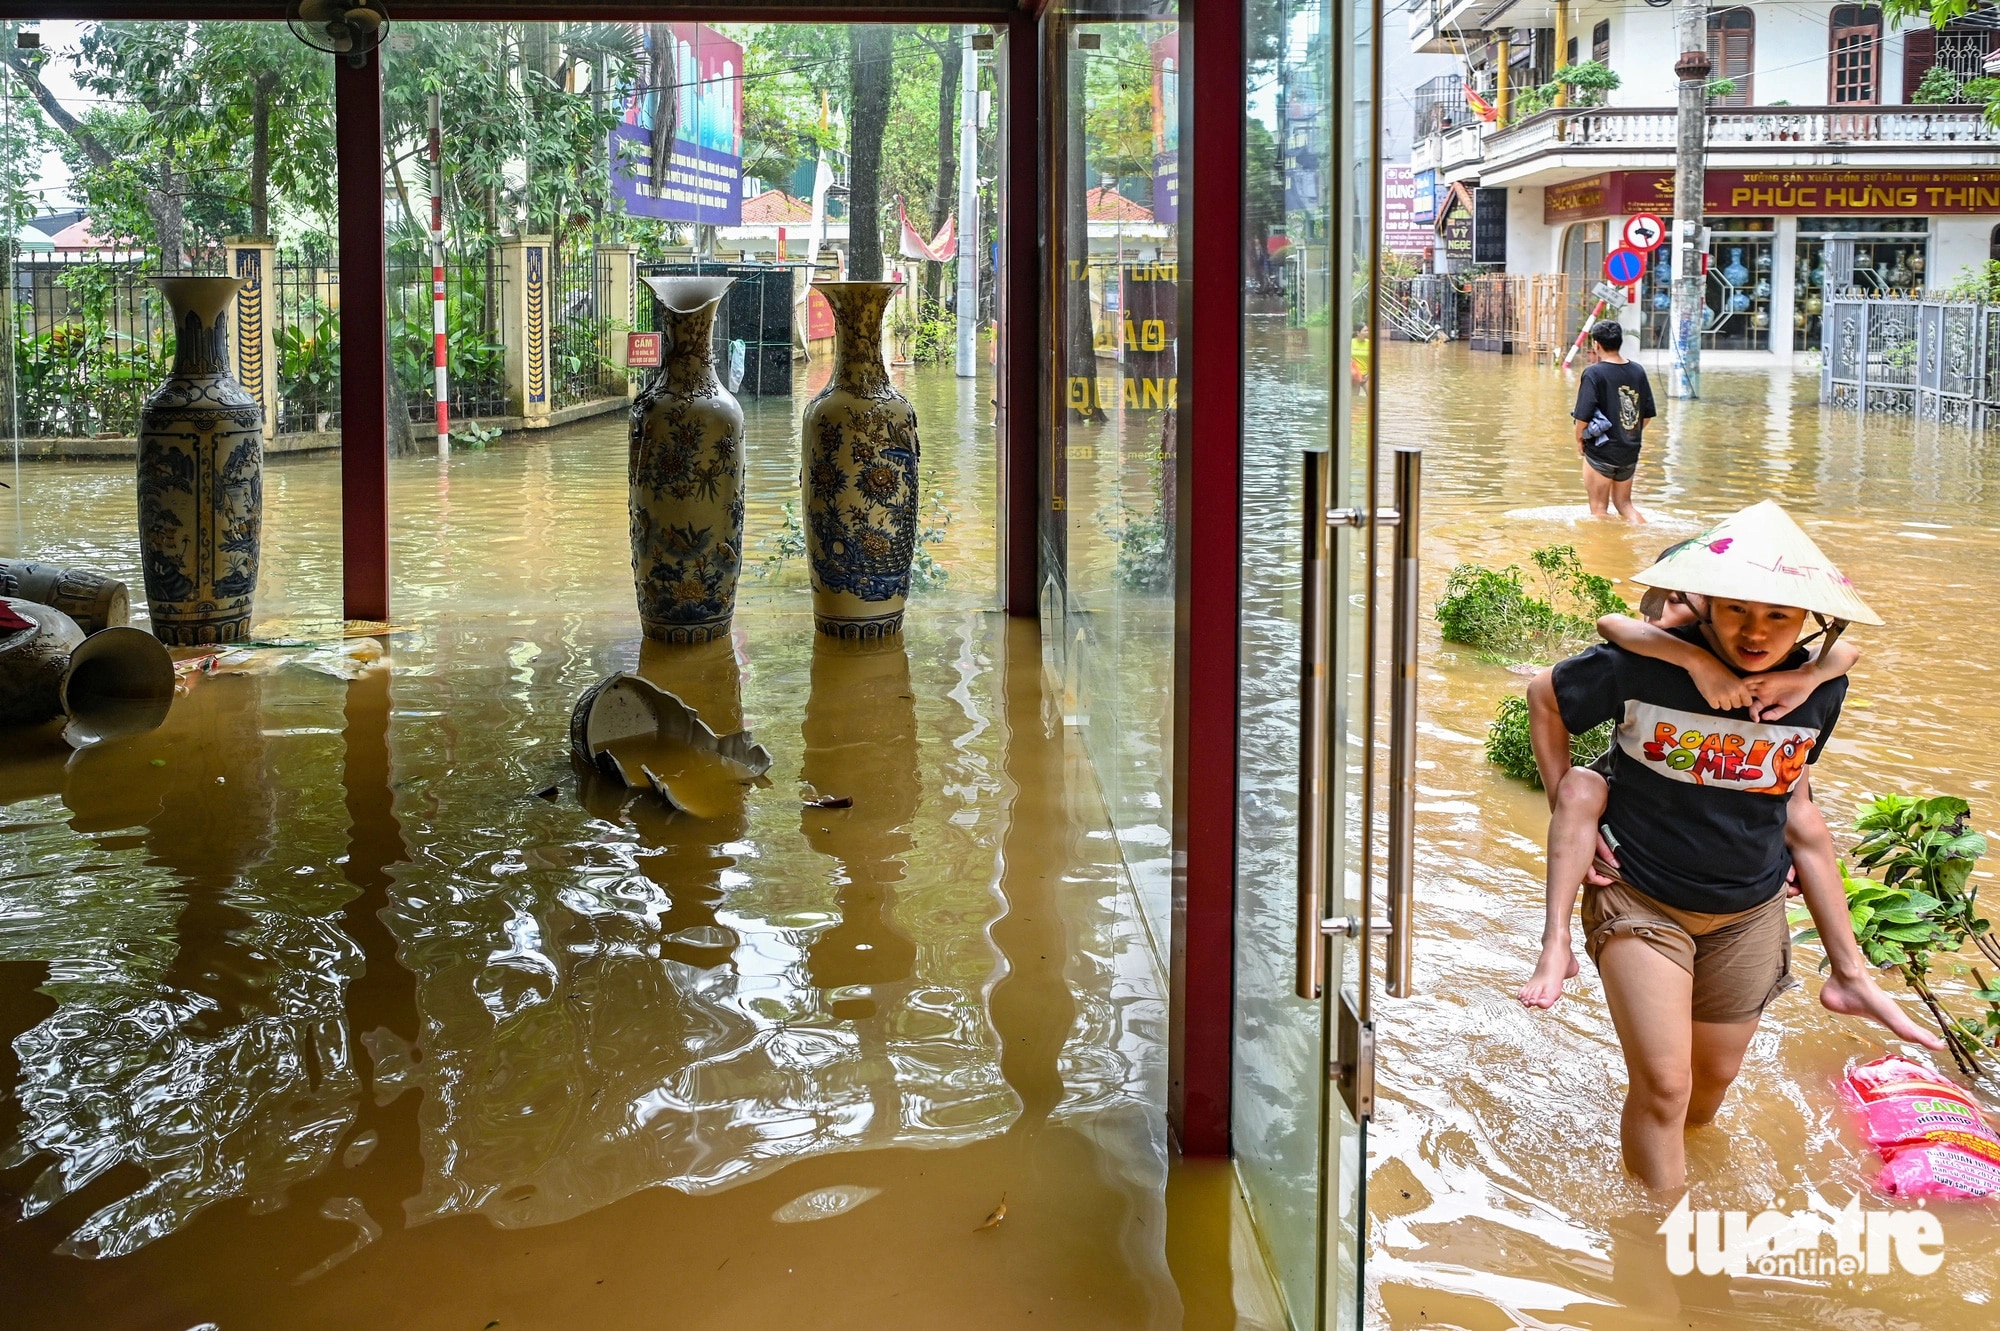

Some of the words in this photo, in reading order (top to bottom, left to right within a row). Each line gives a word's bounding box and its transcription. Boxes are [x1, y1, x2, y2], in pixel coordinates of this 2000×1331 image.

[1906, 174, 1930, 182] LINH
[1387, 180, 1415, 199] HÙNG
[1732, 181, 1817, 207] PHÚC
[1825, 184, 1918, 207] HƯNG
[1447, 240, 1472, 252] NGỌC
[635, 337, 653, 348] CẤM
